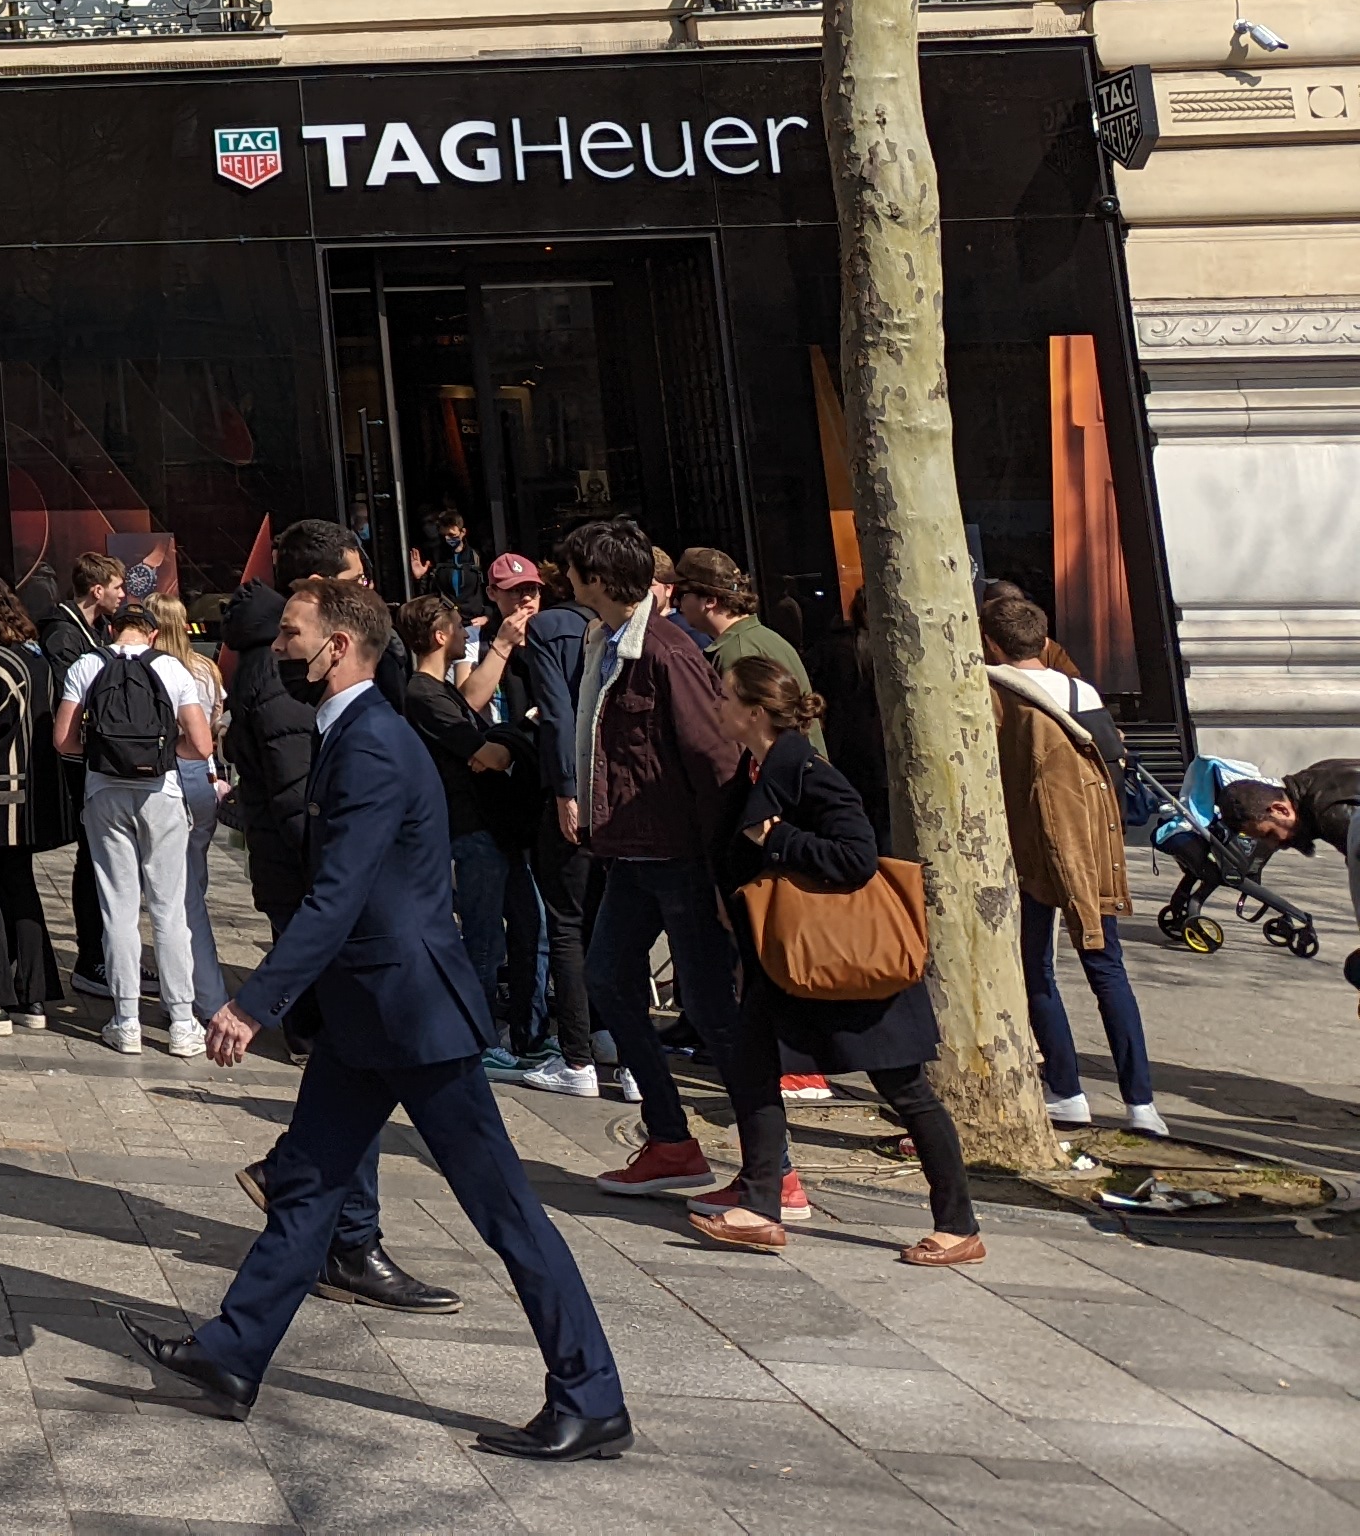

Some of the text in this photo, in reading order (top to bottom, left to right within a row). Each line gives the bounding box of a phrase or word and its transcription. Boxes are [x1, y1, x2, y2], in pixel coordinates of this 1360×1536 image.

[1098, 76, 1134, 114] TAG
[221, 132, 274, 151] TAG
[1101, 112, 1139, 159] HEUER
[222, 154, 276, 182] HEUER
